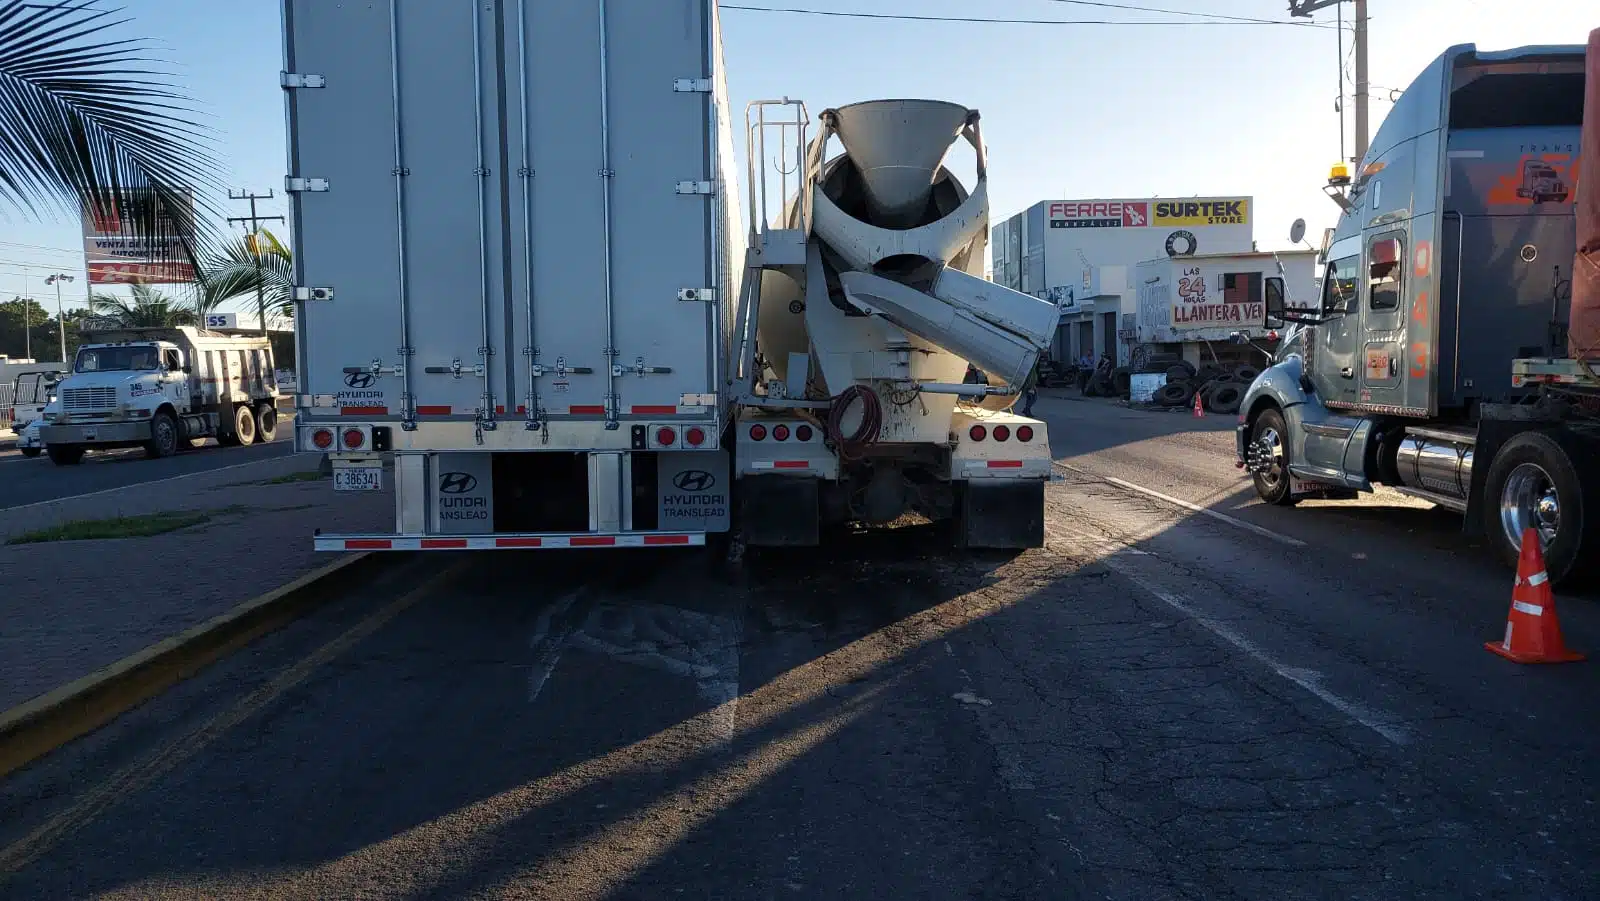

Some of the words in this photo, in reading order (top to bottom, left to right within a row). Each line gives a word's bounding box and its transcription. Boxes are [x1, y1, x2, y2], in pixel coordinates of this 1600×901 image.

[1050, 202, 1121, 217] FERRE
[1156, 201, 1241, 218] SURTEK
[1208, 215, 1242, 224] STORE
[96, 241, 123, 249] VENTA
[1183, 267, 1200, 276] LAS
[1178, 277, 1206, 297] 24
[1174, 305, 1240, 322] LLANTERA
[338, 391, 383, 399] HYUNDAI
[336, 473, 342, 484] C
[344, 473, 378, 485] 386341
[664, 495, 725, 505] HYUNDAI
[664, 507, 725, 517] TRANSLEAD
